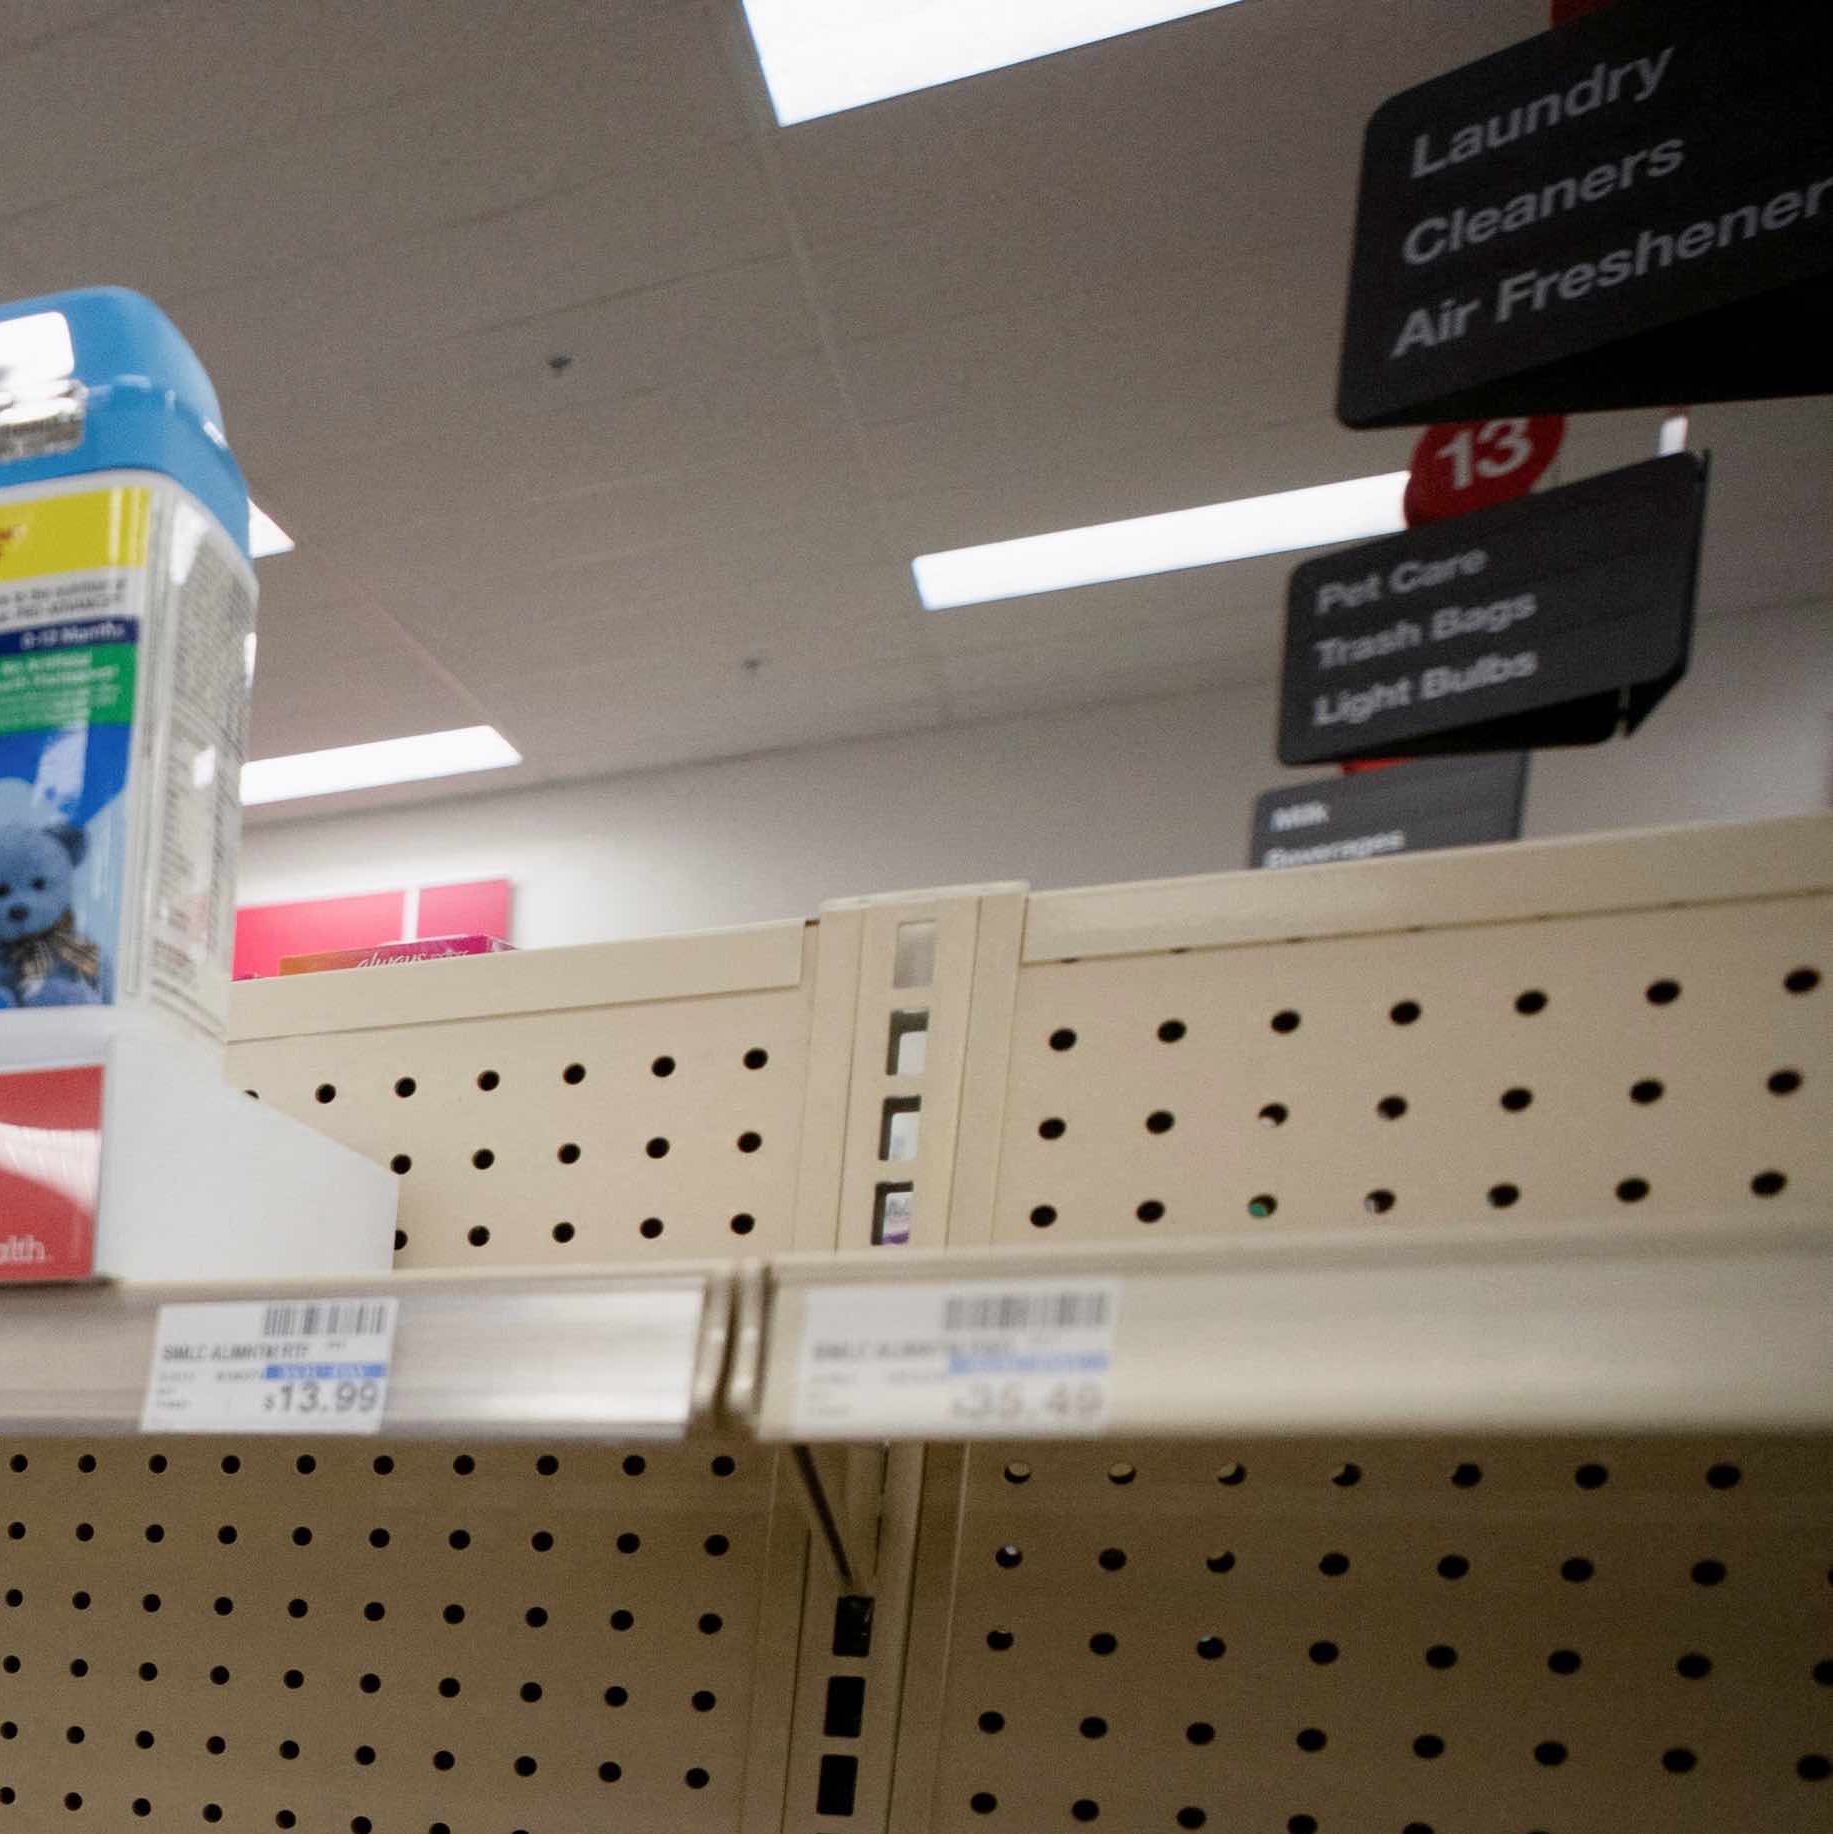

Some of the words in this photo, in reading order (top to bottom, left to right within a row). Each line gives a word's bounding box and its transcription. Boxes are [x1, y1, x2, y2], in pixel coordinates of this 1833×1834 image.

[1411, 46, 1675, 182] Laundry
[1402, 135, 1687, 268] Cleaners
[1389, 298, 1481, 360] Air
[1432, 416, 1533, 492] 13
[1315, 573, 1382, 616] Pet
[1388, 548, 1489, 595] Care
[1313, 619, 1423, 671] Trash
[1430, 592, 1538, 642] Bags
[1312, 676, 1414, 728] Light
[1420, 650, 1539, 700] Bulbs
